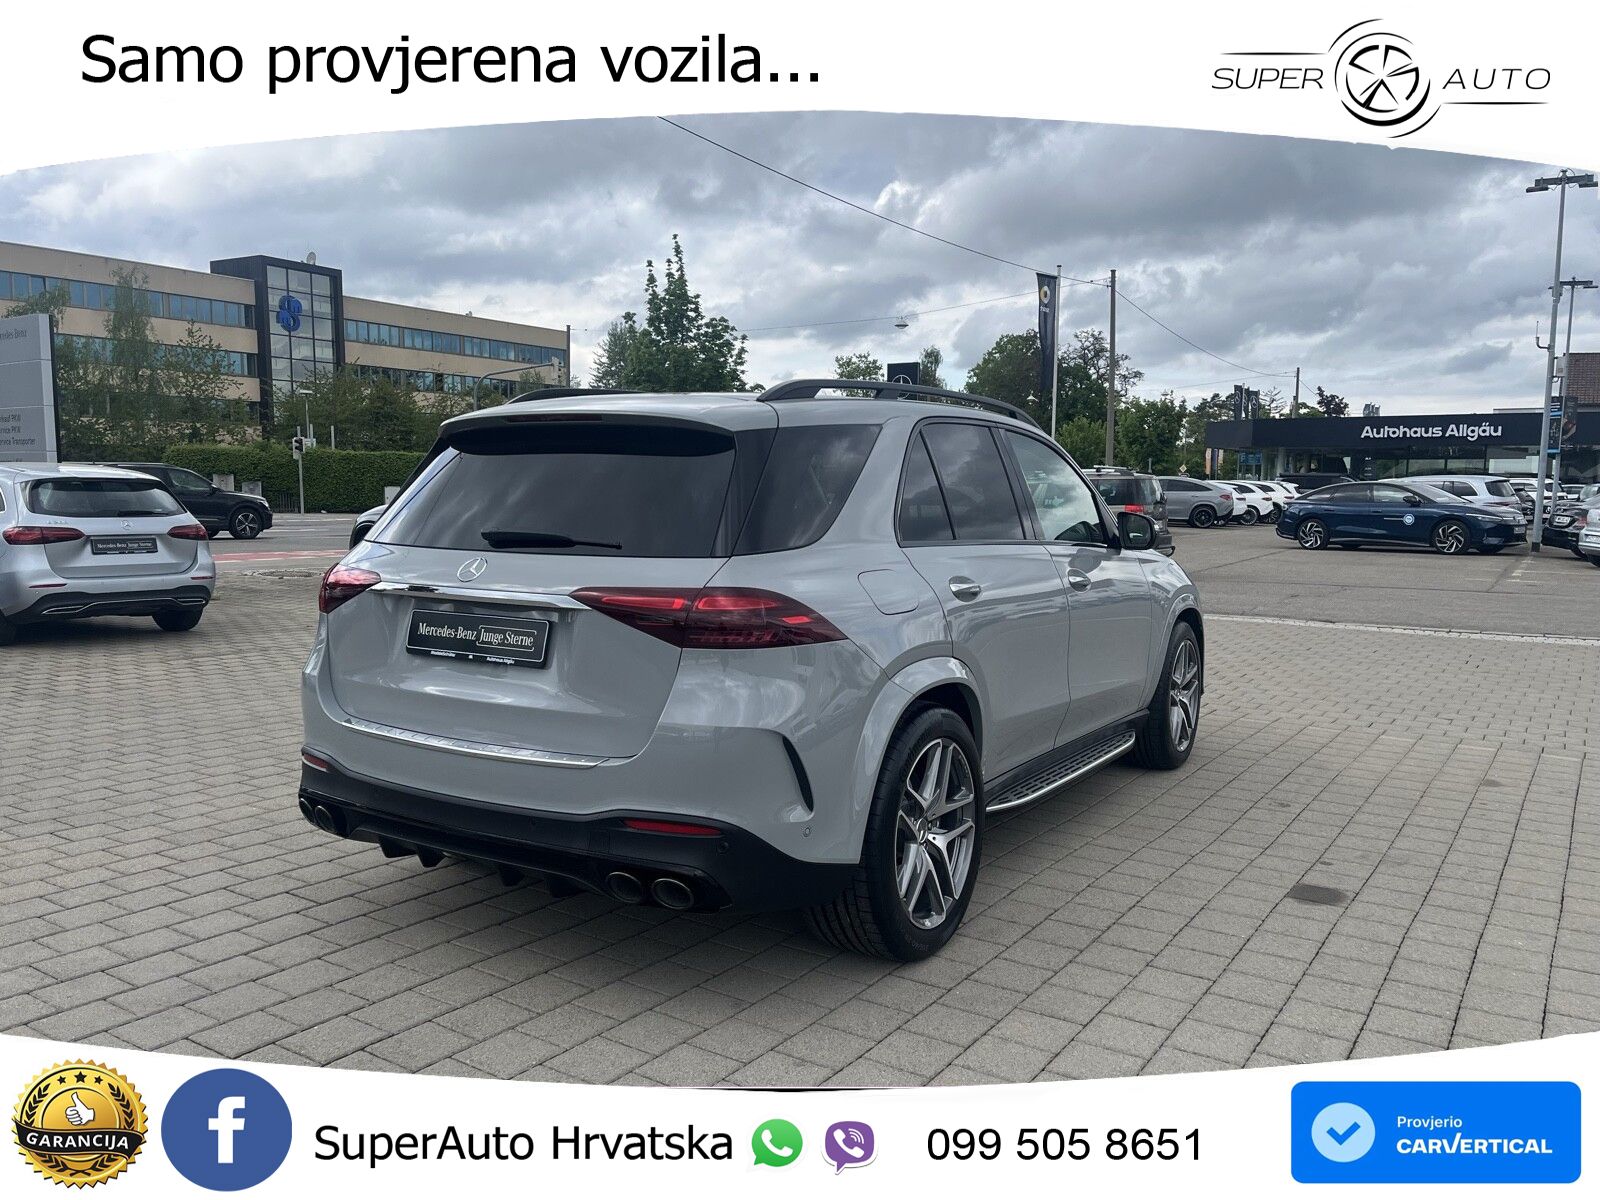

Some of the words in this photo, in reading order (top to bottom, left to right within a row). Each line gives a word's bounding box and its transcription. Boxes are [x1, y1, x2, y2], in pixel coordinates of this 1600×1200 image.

[1360, 425, 1443, 439] Autohaus
[1445, 422, 1503, 442] Allgäu
[417, 622, 477, 640] Mercedes-Benz
[478, 628, 504, 646] Junge
[504, 631, 534, 647] Sterne
